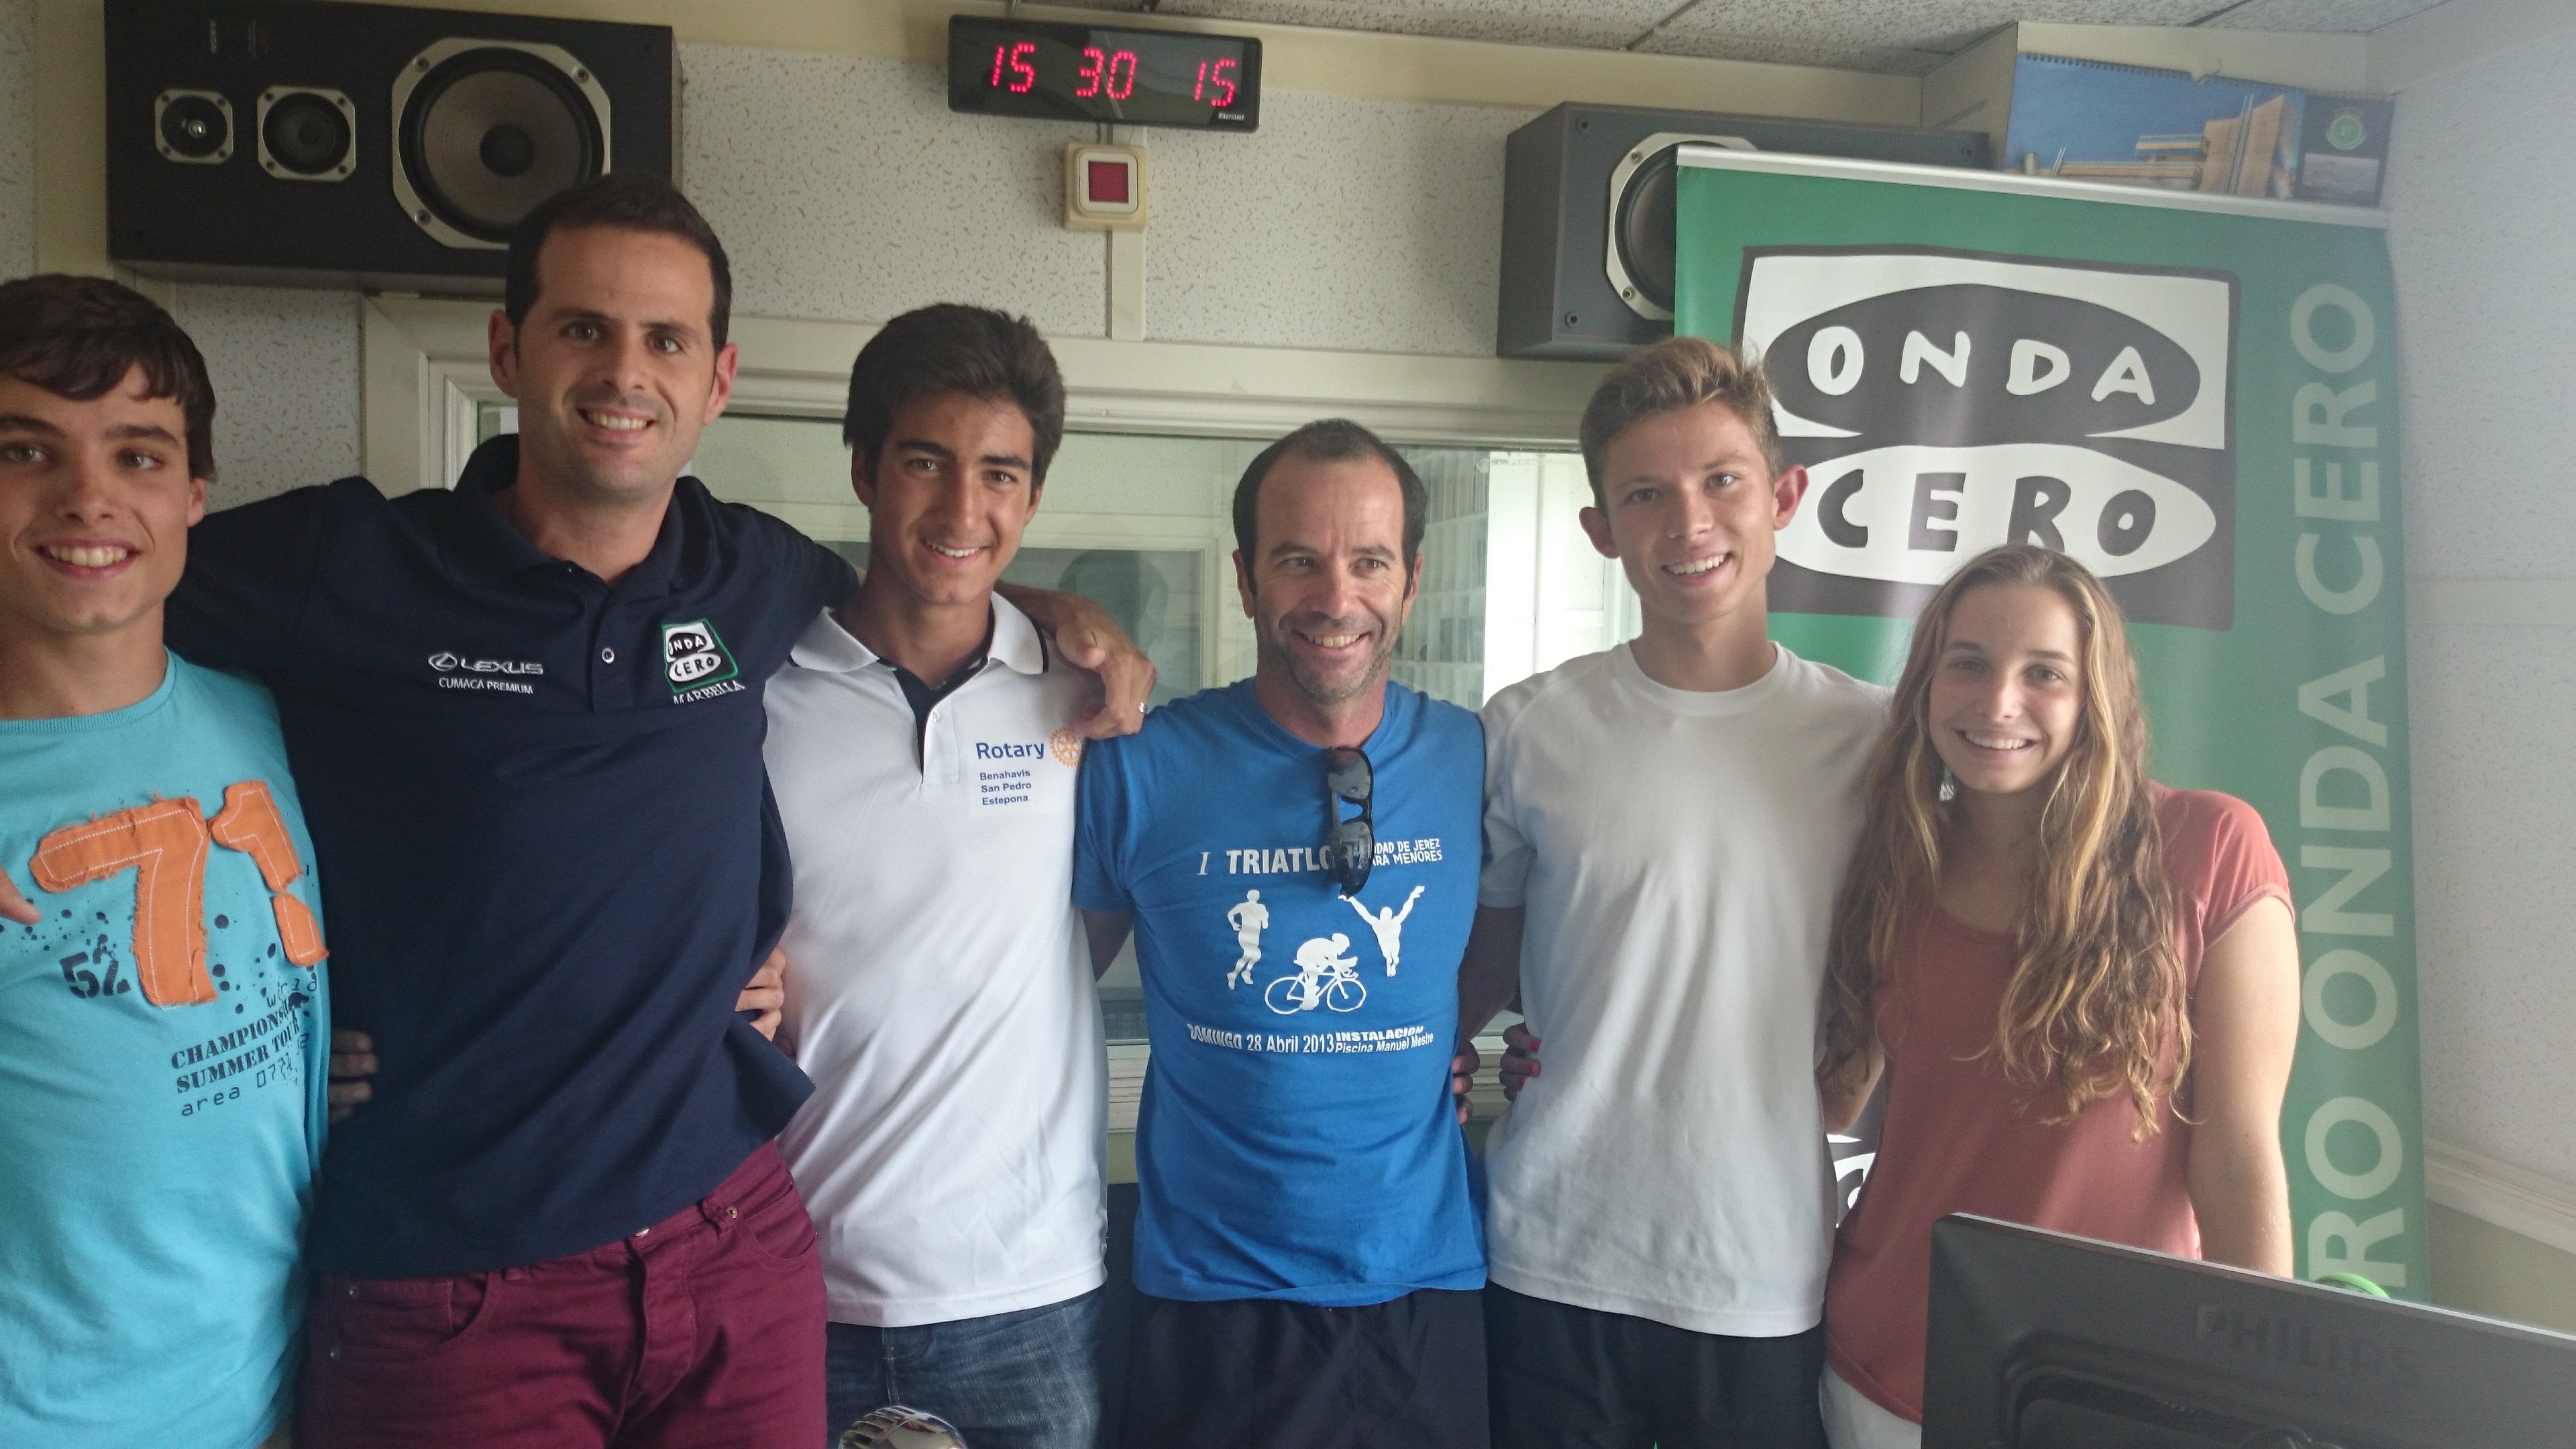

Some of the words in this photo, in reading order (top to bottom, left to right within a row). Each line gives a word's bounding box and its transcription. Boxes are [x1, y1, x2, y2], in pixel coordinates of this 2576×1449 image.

[991, 41, 1035, 94] 15
[1076, 47, 1137, 100] 30
[1193, 59, 1236, 107] 15
[1807, 326, 2155, 405] ONDA
[2289, 283, 2383, 615] CERO
[1817, 468, 2156, 556] CERO
[460, 657, 544, 676] LEXUS
[438, 677, 484, 690] CUMACA
[486, 680, 534, 695] PREMIUM
[673, 680, 746, 704] MARBELLA
[975, 741, 1044, 759] Rotary
[981, 785, 1000, 793] San
[1003, 782, 1032, 792] Pedro
[982, 794, 1028, 806] Estepona
[1393, 849, 1442, 865] MENORES
[1397, 841, 1410, 853] DE
[1413, 839, 1440, 852] JEREZ
[2298, 654, 2398, 1050] ONDA
[1197, 851, 1211, 875] I
[1226, 847, 1334, 875] TRIATLO
[58, 945, 131, 998] 52
[1187, 1023, 1242, 1049] DOMINGO
[1246, 1034, 1262, 1052] 28
[1266, 1034, 1299, 1053] Abril
[1302, 1033, 1334, 1053] 2013
[1335, 1026, 1424, 1042] INSTALACION
[1335, 1042, 1373, 1054] Piscina
[1375, 1036, 1409, 1053] Manuel
[1410, 1032, 1434, 1048] Mestre
[176, 1044, 270, 1093] SUMMER
[272, 1020, 299, 1053] TOUR
[181, 1086, 240, 1116] area
